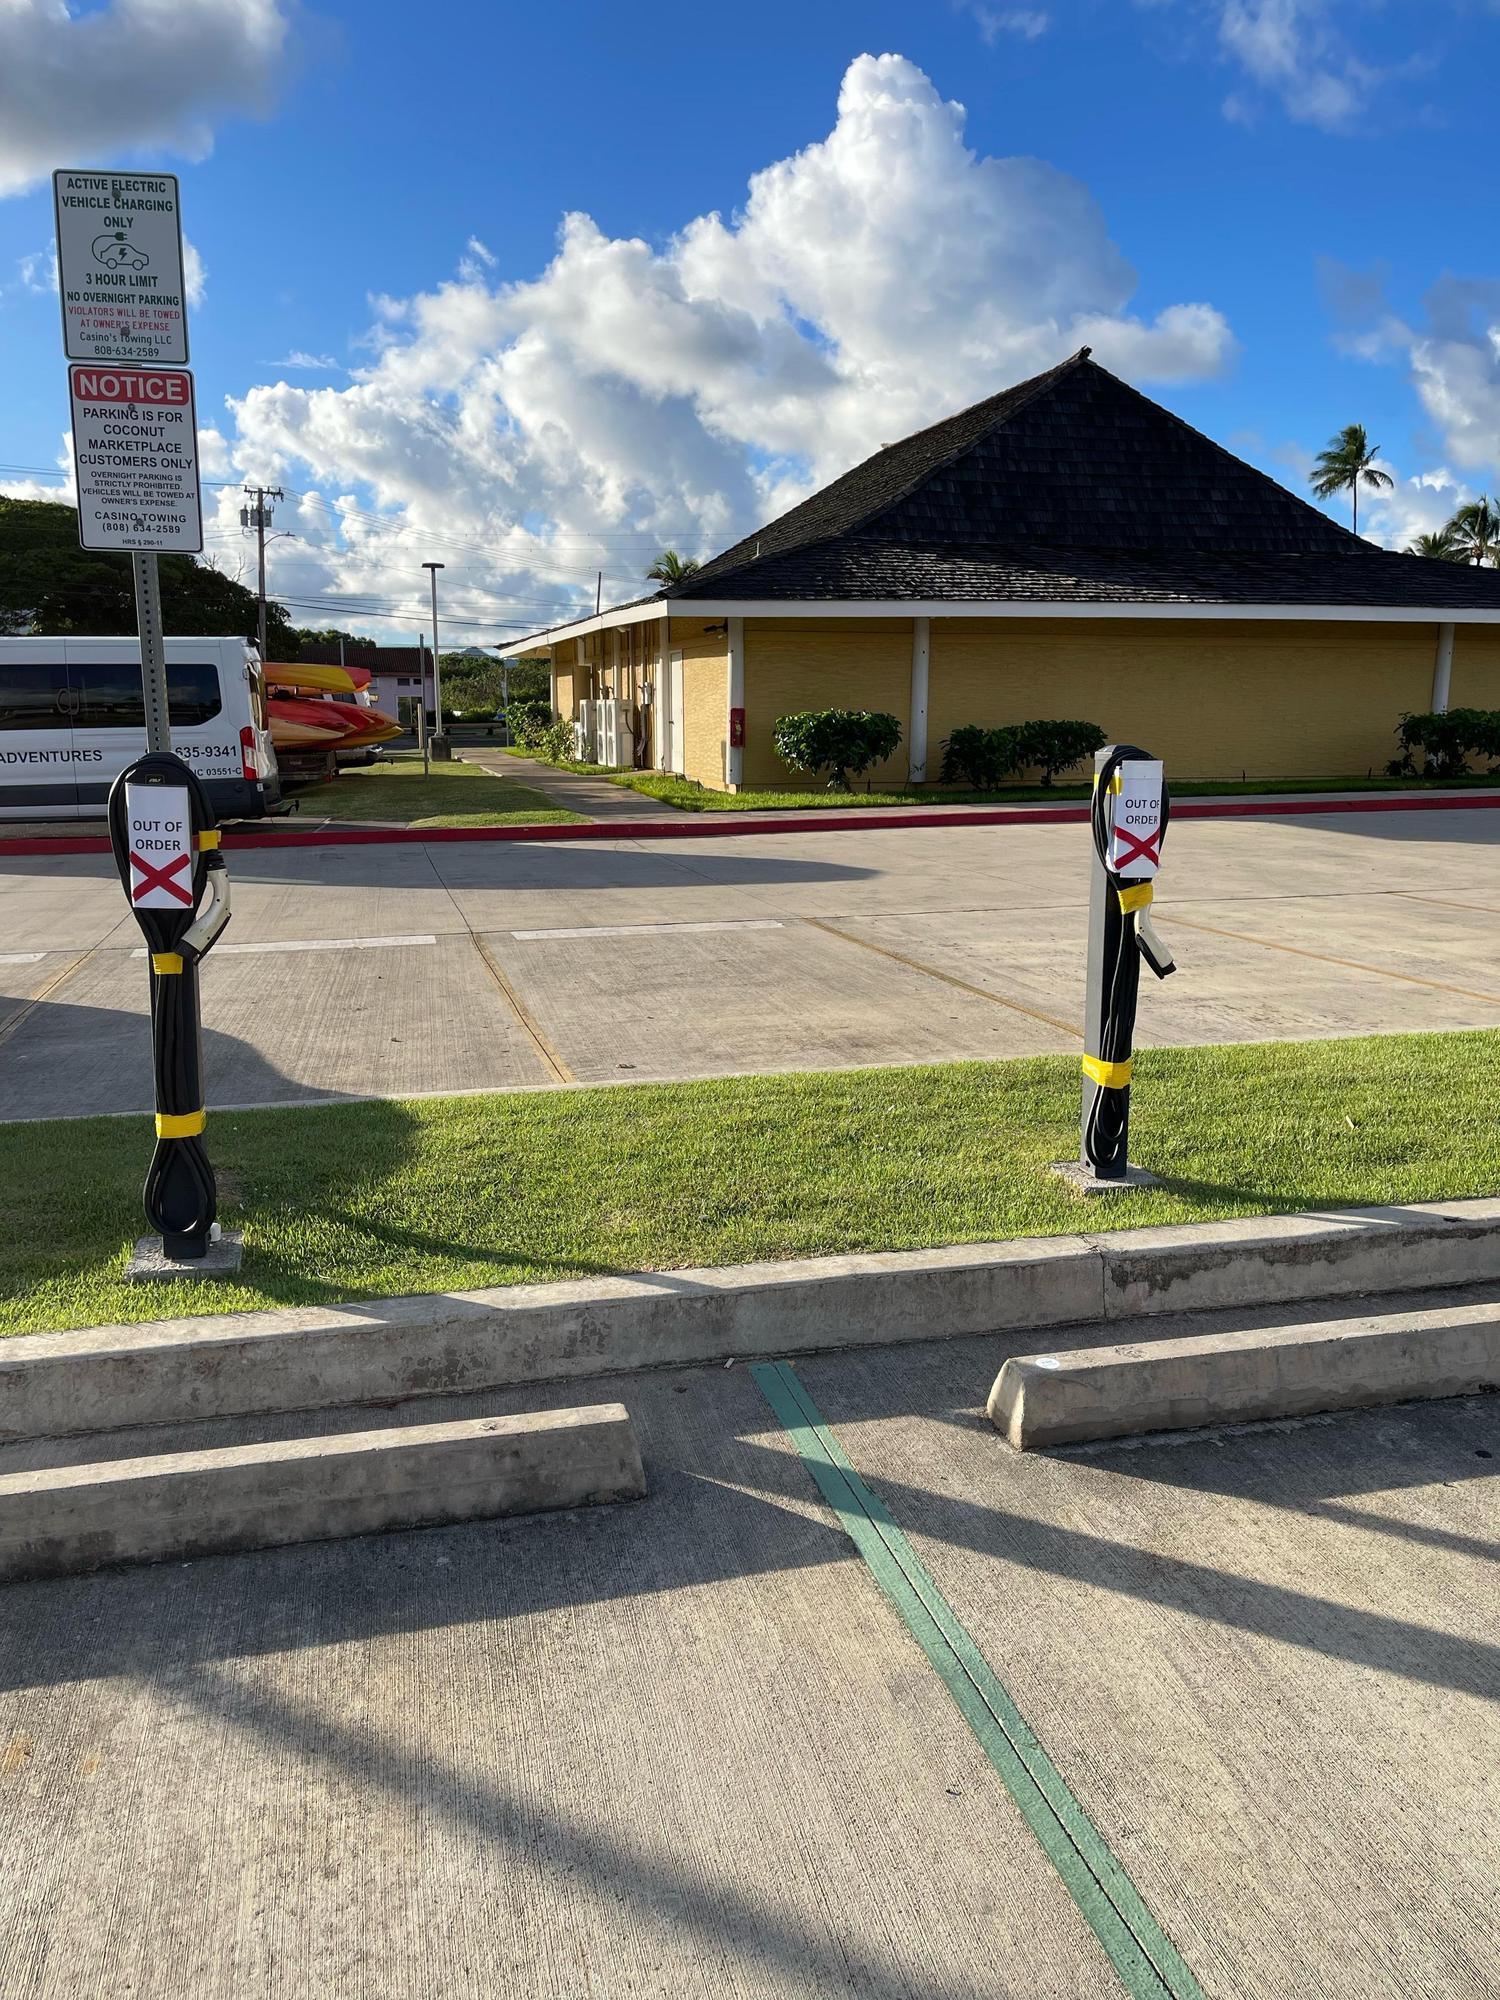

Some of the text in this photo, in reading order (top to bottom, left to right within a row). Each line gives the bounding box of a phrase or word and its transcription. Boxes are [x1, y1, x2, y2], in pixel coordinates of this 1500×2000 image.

[67, 178, 166, 192] ACTIVE ELECTRIC
[62, 196, 173, 211] VEHICLE CHARGING
[104, 216, 134, 228] ONLY
[86, 274, 158, 287] 3 HOUR LIMIT
[68, 292, 179, 306] NO OVERNIGHT PARKING
[68, 307, 180, 319] VIOLATORS WILL BE TOWED
[94, 320, 129, 329] OWNER'S
[133, 322, 169, 330] EXPENSE
[80, 333, 172, 344] Casino's Towing LLC
[94, 346, 159, 356] 808-634-2589
[80, 375, 183, 400] NOTICE
[84, 408, 183, 422] PARKING IS FOR
[104, 425, 165, 437] COCONUT
[88, 440, 182, 453] MARKETPLACE
[80, 455, 193, 469] CUSTOMERS ONLY
[91, 471, 136, 479] OVERNIGHT
[95, 512, 186, 522] CASINO TOWING
[103, 523, 180, 533] (808) 634-2589
[0, 750, 102, 763] ADVENTURES
[176, 745, 236, 758] 635-9341
[1126, 799, 1159, 808] OUT OF
[1126, 815, 1158, 824] ORDER
[133, 821, 182, 832] OUT OF
[136, 839, 181, 850] ORDER
